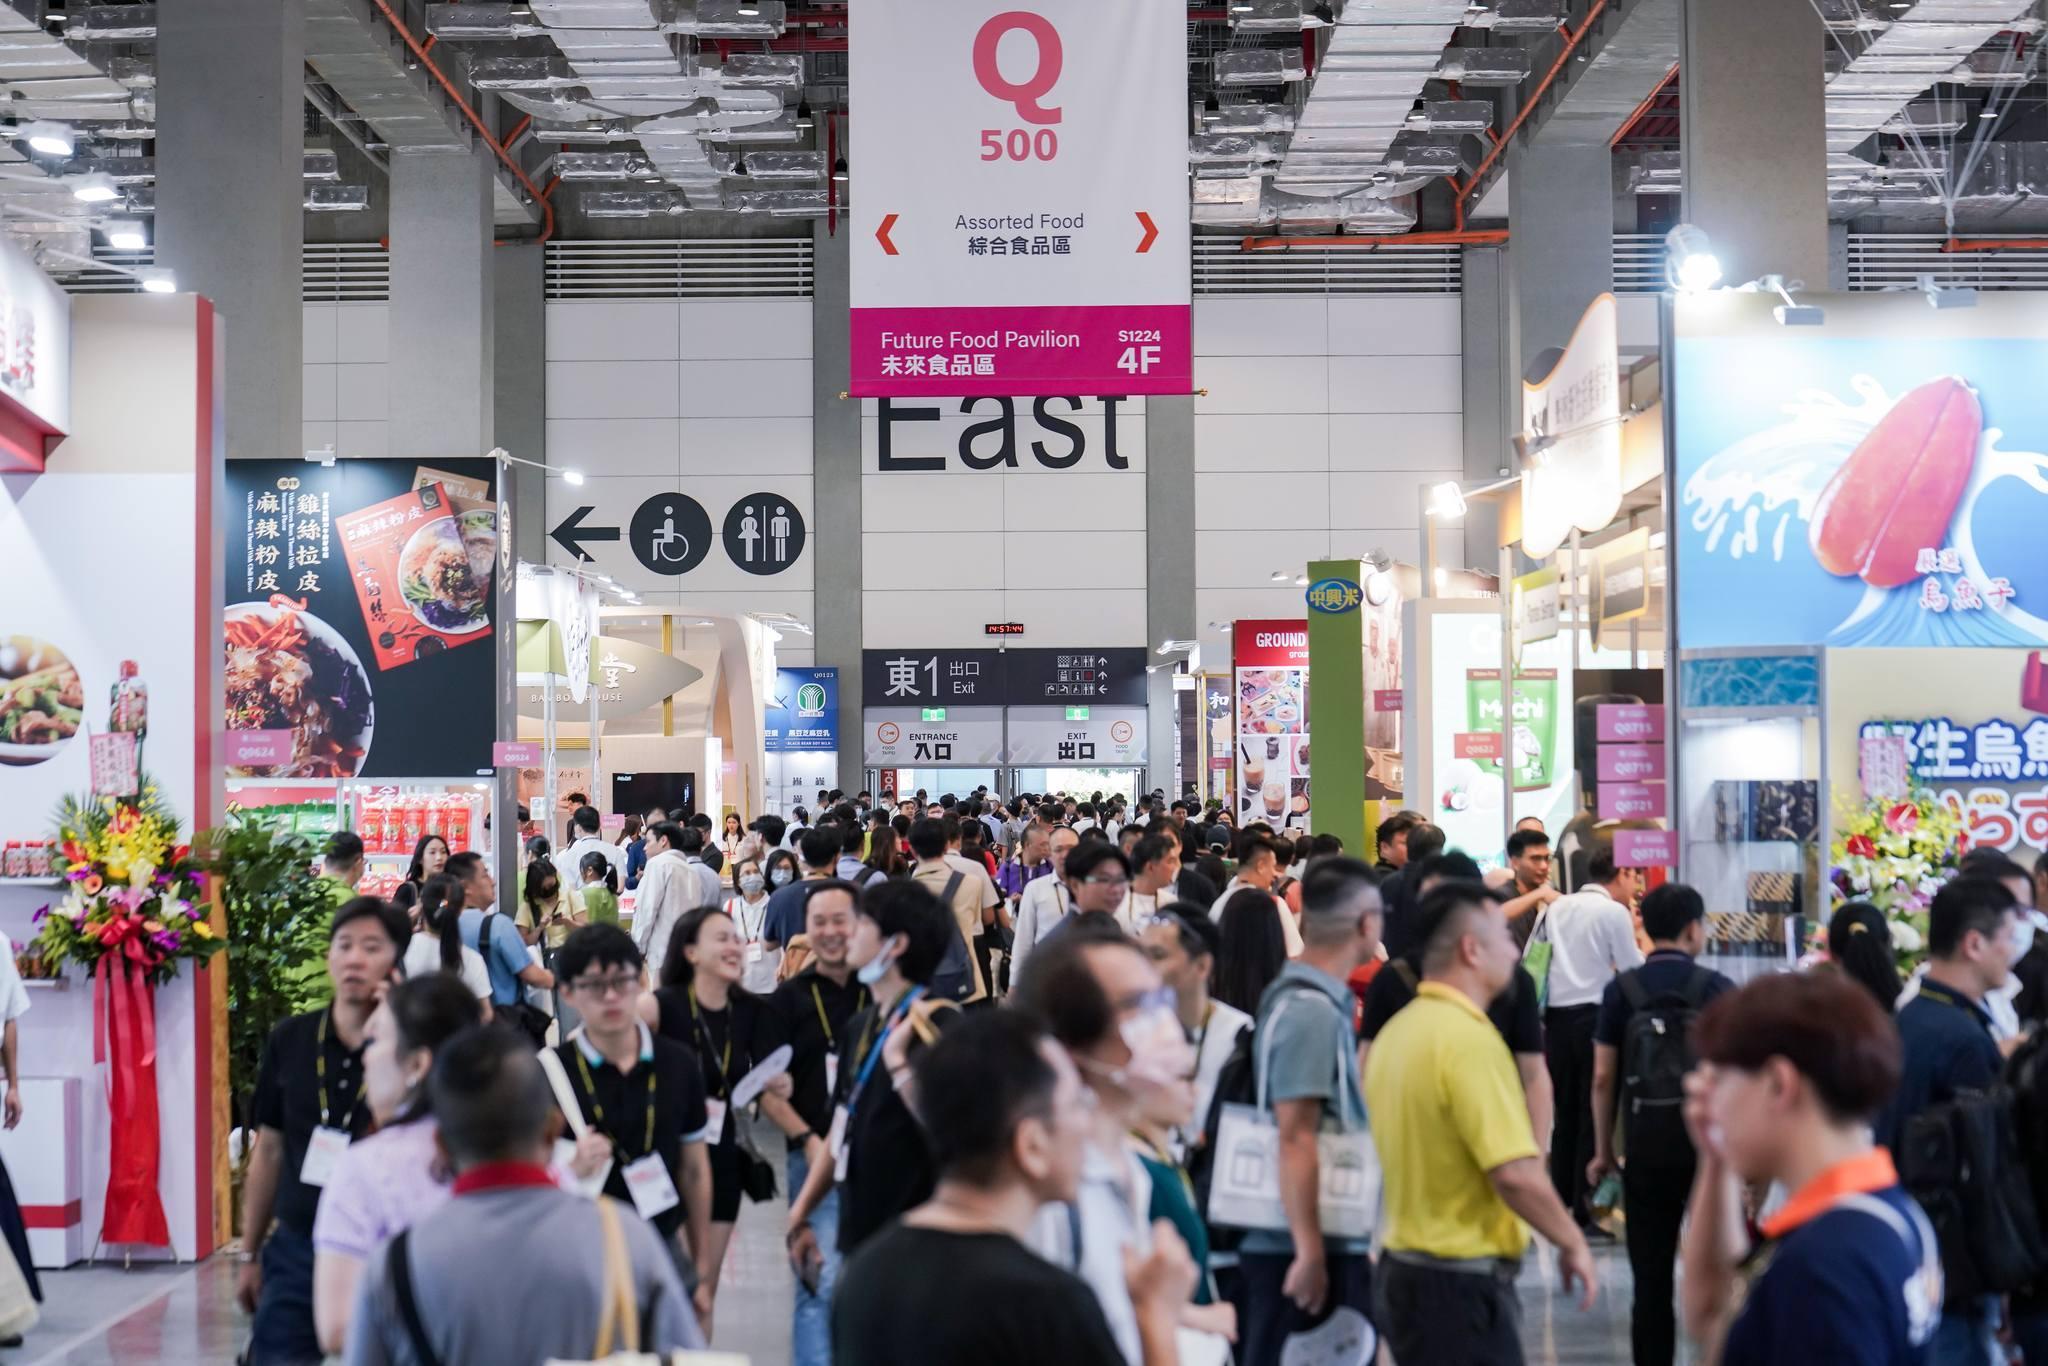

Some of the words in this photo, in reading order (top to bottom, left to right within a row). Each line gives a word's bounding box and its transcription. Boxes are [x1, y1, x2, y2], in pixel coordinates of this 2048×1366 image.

[972, 11, 1064, 125] Q
[980, 129, 1058, 161] 500
[955, 214, 1034, 230] Assorted
[1040, 213, 1084, 230] Food
[968, 236, 1071, 256] 綜合食品區
[881, 332, 943, 349] Future
[949, 331, 999, 349] Food
[1005, 330, 1080, 349] Pavilion
[1118, 330, 1161, 342] S1224
[881, 354, 995, 377] 未來食品區
[1117, 347, 1161, 375] 4F
[878, 396, 1129, 471] East
[255, 491, 280, 591] 麻辣粉皮
[297, 493, 321, 592] 雞絲拉皮
[1309, 588, 1359, 606] 中興米
[989, 625, 1023, 633] 14:57:44
[1256, 632, 1306, 648] GROUND
[884, 656, 938, 697] 東1
[950, 661, 980, 676] 出口
[953, 681, 975, 694] Exit
[1209, 692, 1229, 709] 和
[1479, 697, 1544, 719] Mchi
[909, 733, 958, 741] ENTRANCE
[1067, 732, 1087, 740] EXIT
[914, 743, 951, 760] 入口
[1058, 742, 1095, 760] 出口
